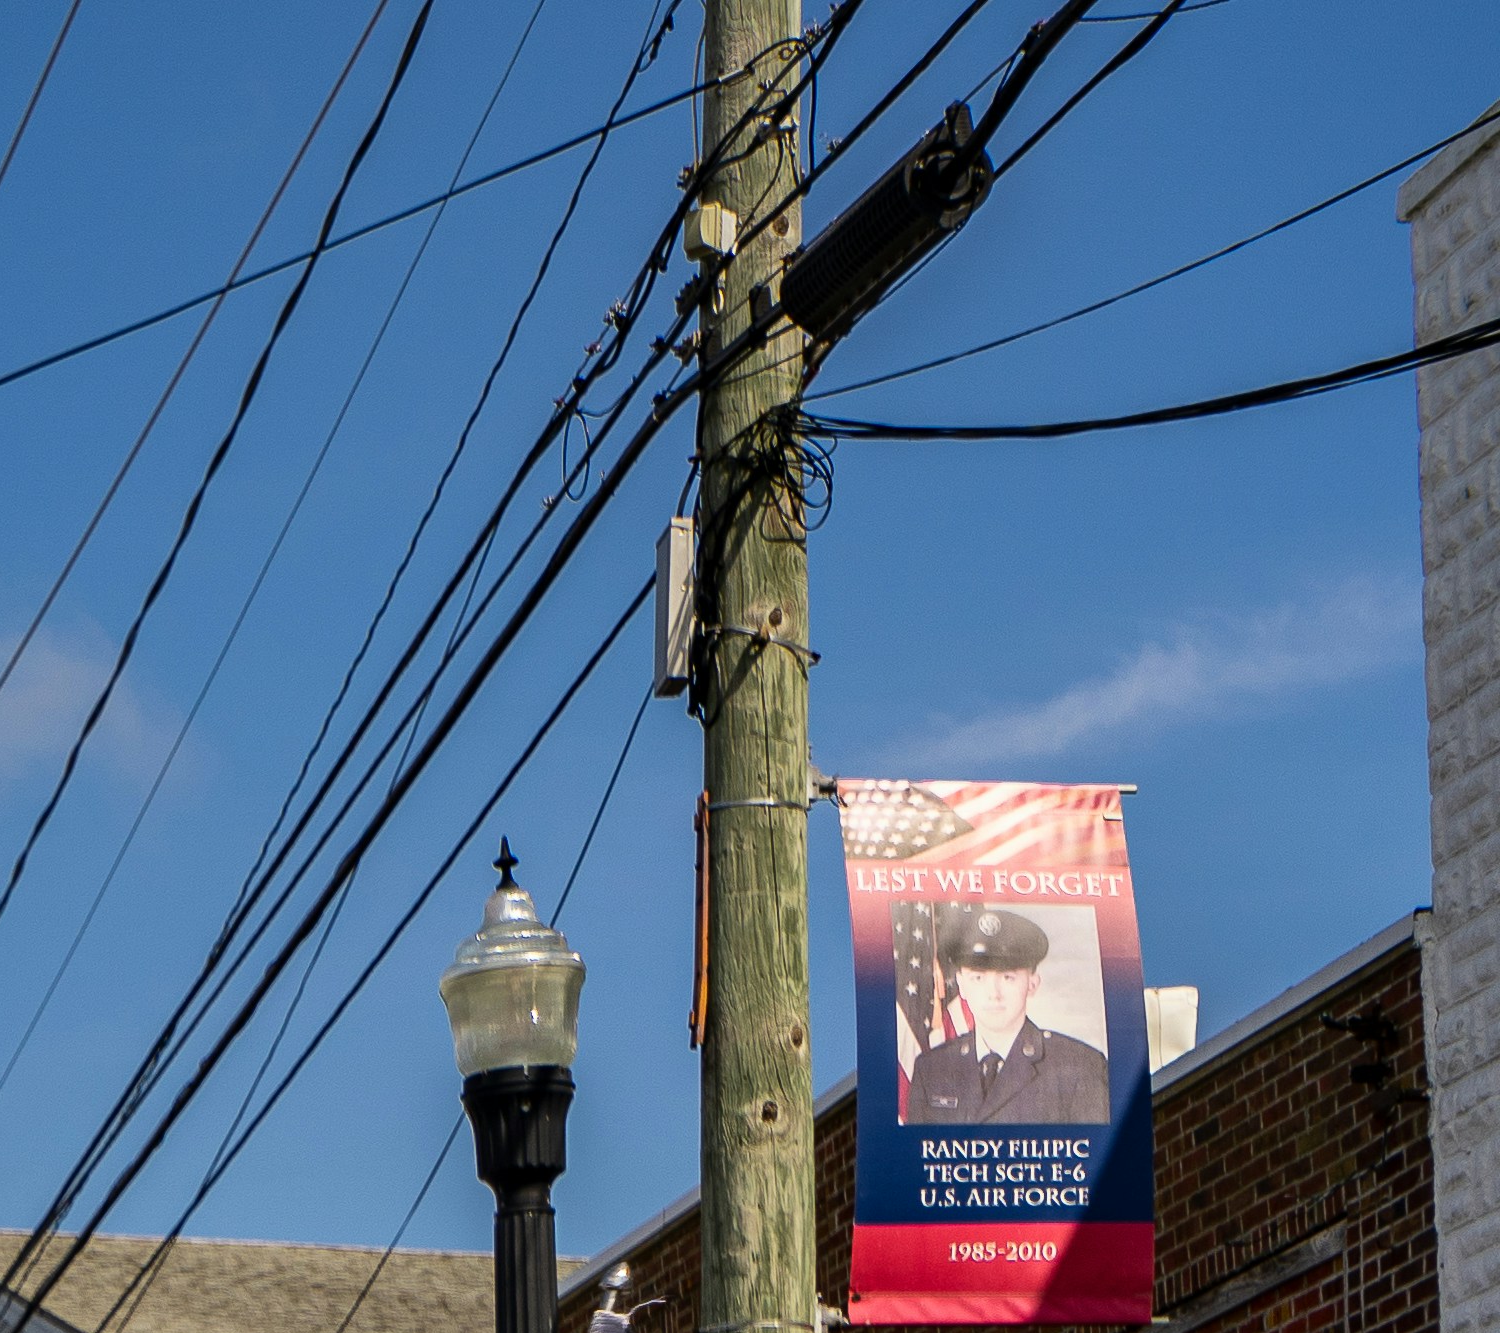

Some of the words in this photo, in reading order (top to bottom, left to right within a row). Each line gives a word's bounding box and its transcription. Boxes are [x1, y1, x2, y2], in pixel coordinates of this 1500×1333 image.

[855, 867, 927, 893] LEST
[935, 868, 985, 894] WE
[994, 870, 1125, 898] FORGET
[921, 1138, 1003, 1160] RANDY
[1008, 1138, 1090, 1160] FILIPIC
[924, 1163, 989, 1184] TECH
[995, 1163, 1045, 1184] SGT.
[1051, 1163, 1086, 1184] E-6
[920, 1187, 963, 1208] U.S.
[968, 1187, 1009, 1208] AIR
[1011, 1187, 1090, 1208] FORCE
[948, 1240, 1058, 1263] 1985-2010
